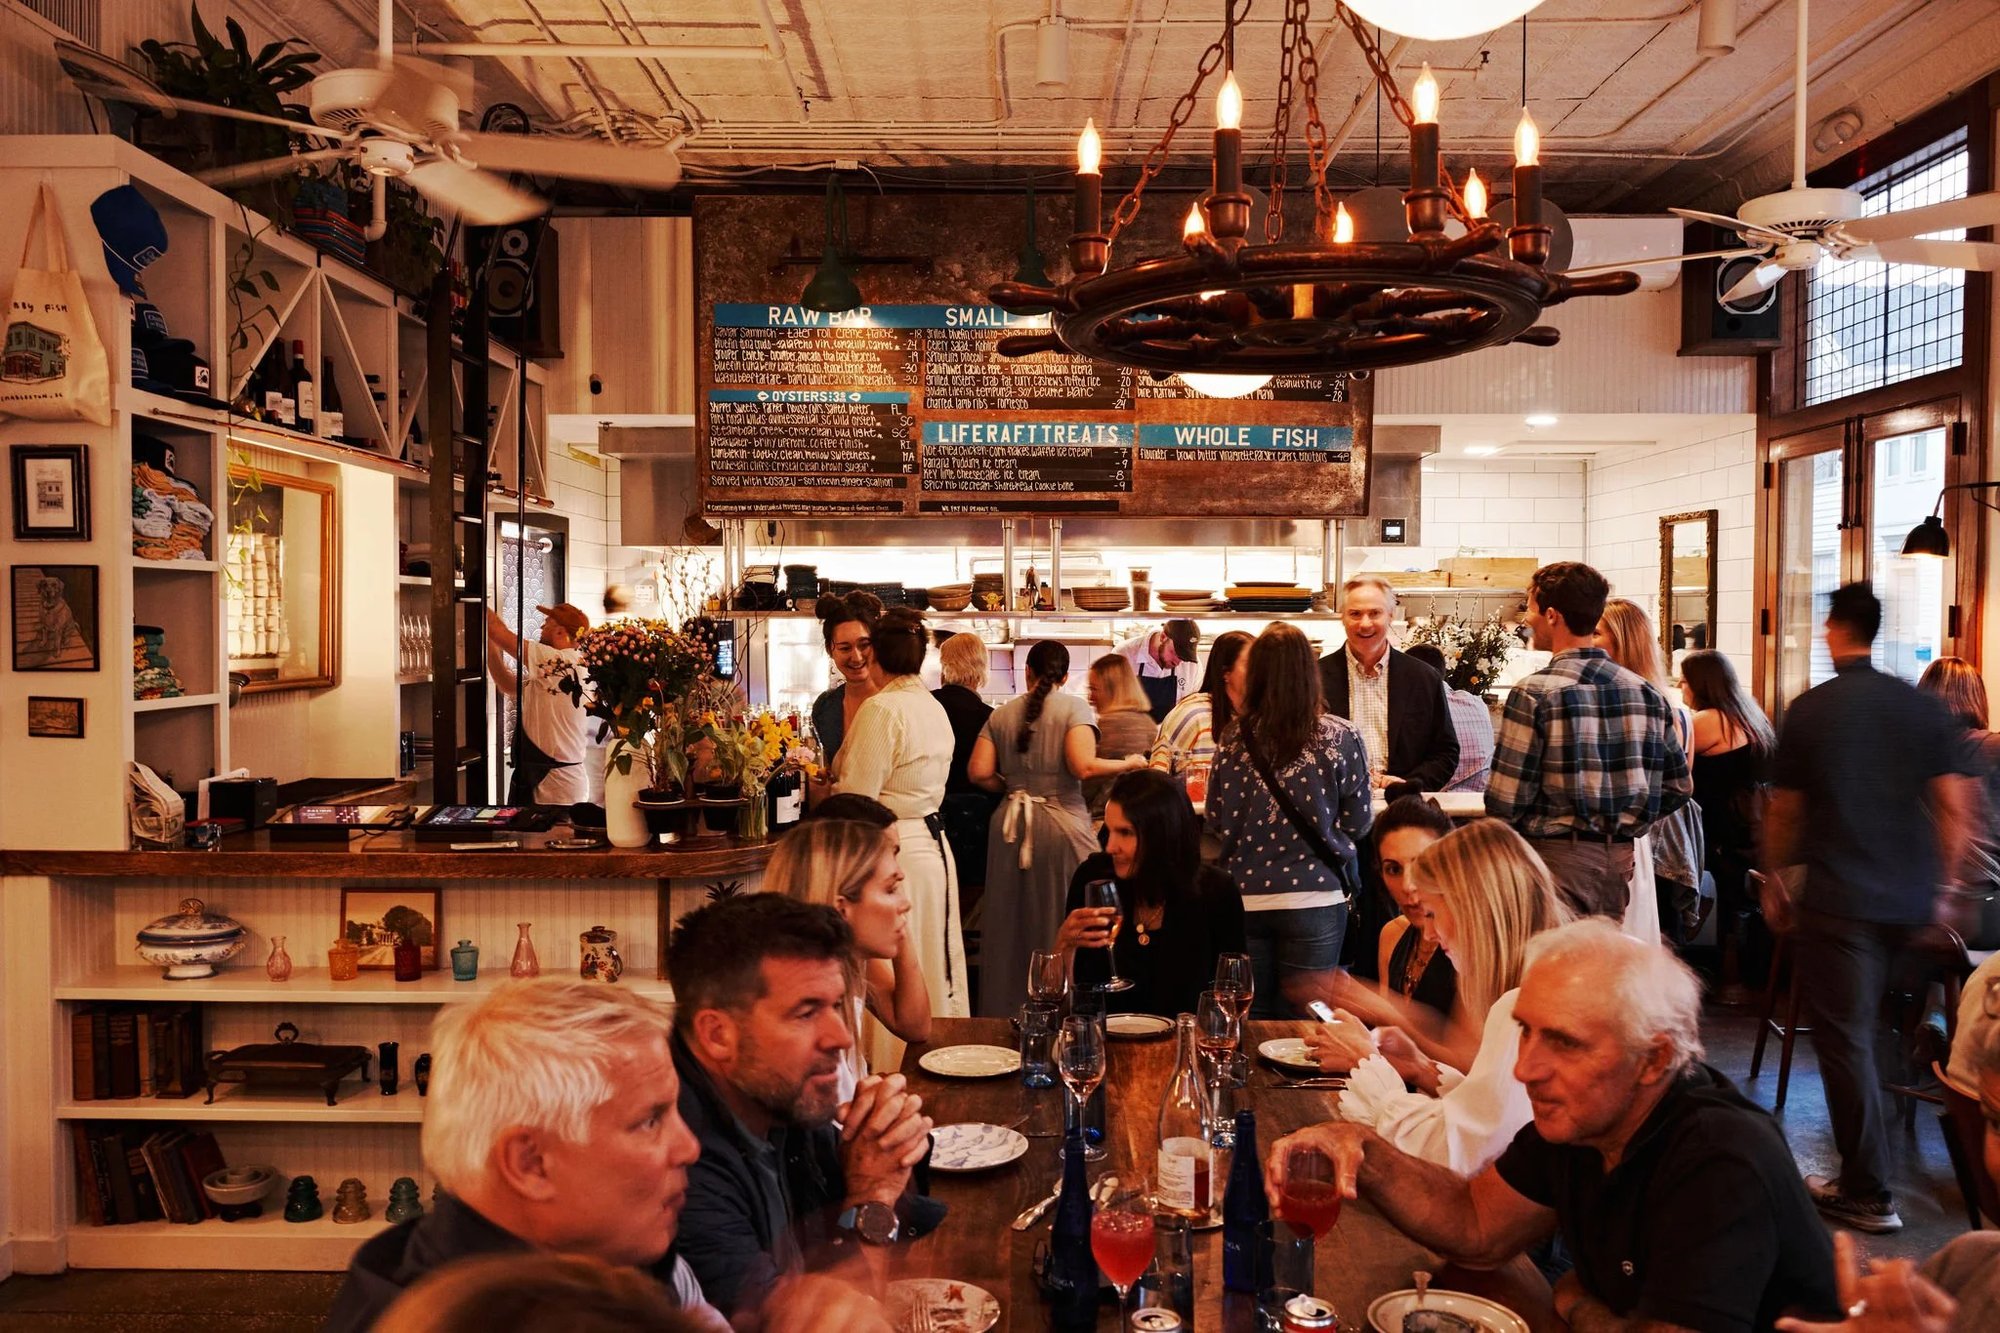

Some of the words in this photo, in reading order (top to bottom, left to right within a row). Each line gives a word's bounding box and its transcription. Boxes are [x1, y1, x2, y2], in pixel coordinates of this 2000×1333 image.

[769, 307, 821, 326] RAW
[828, 307, 872, 326] BAR
[945, 308, 1011, 327] SMALL
[899, 415, 914, 427] SC
[1174, 427, 1250, 447] WHOLE
[1272, 427, 1318, 448] FISH
[711, 475, 740, 486] Served
